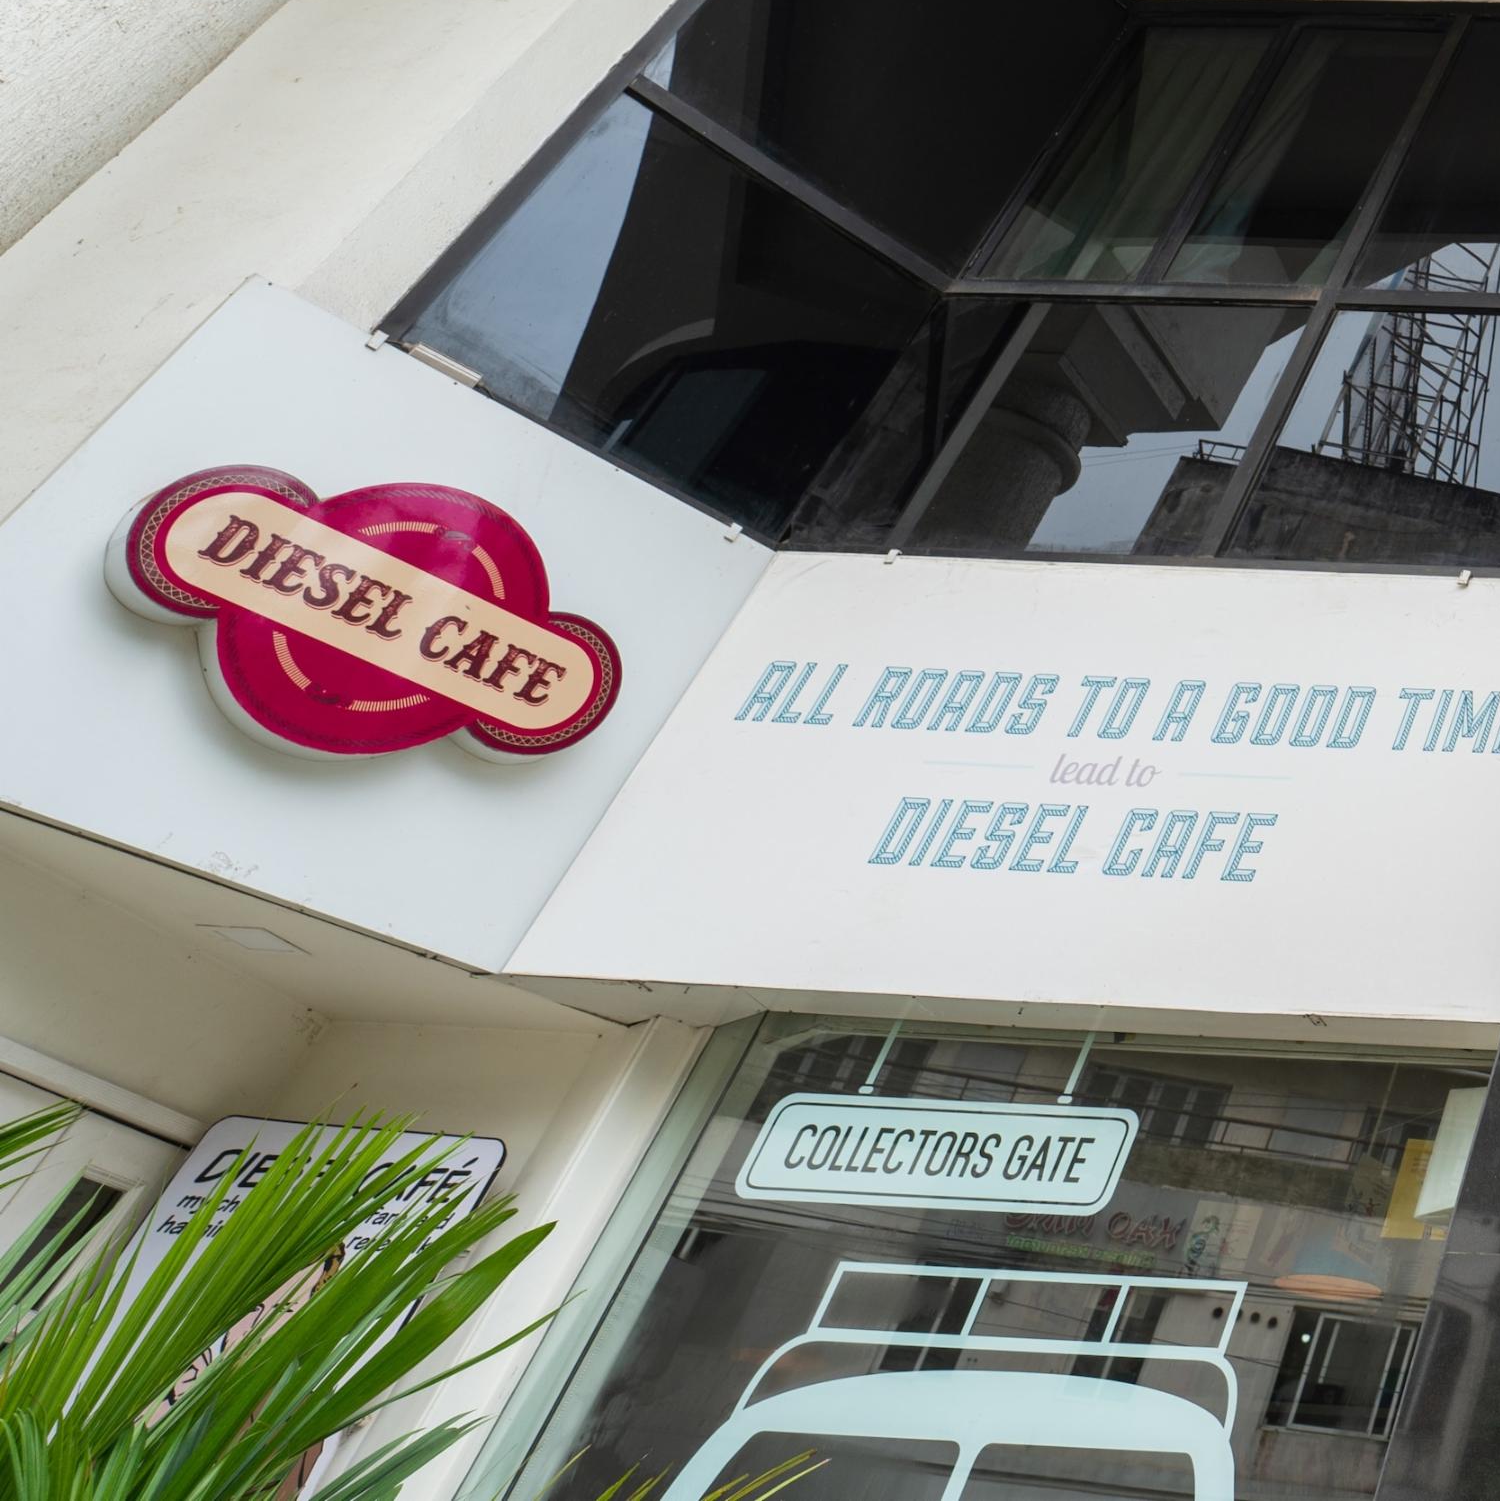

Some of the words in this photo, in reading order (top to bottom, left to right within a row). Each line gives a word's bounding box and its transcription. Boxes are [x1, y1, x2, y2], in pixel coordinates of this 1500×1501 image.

[198, 515, 412, 641] DIESEL
[420, 616, 567, 707] CAFE
[734, 660, 849, 725] ALL
[853, 666, 1060, 736] ROADS
[1066, 675, 1151, 740] TO
[1152, 679, 1206, 742] A
[1210, 681, 1377, 749] GOOD
[1049, 751, 1118, 788] lead
[1122, 757, 1162, 789] to
[867, 796, 1089, 875] DIESEL
[1102, 807, 1278, 882] CAFE
[783, 1124, 1001, 1179] COLLECTORS
[1002, 1135, 1096, 1185] GATE
